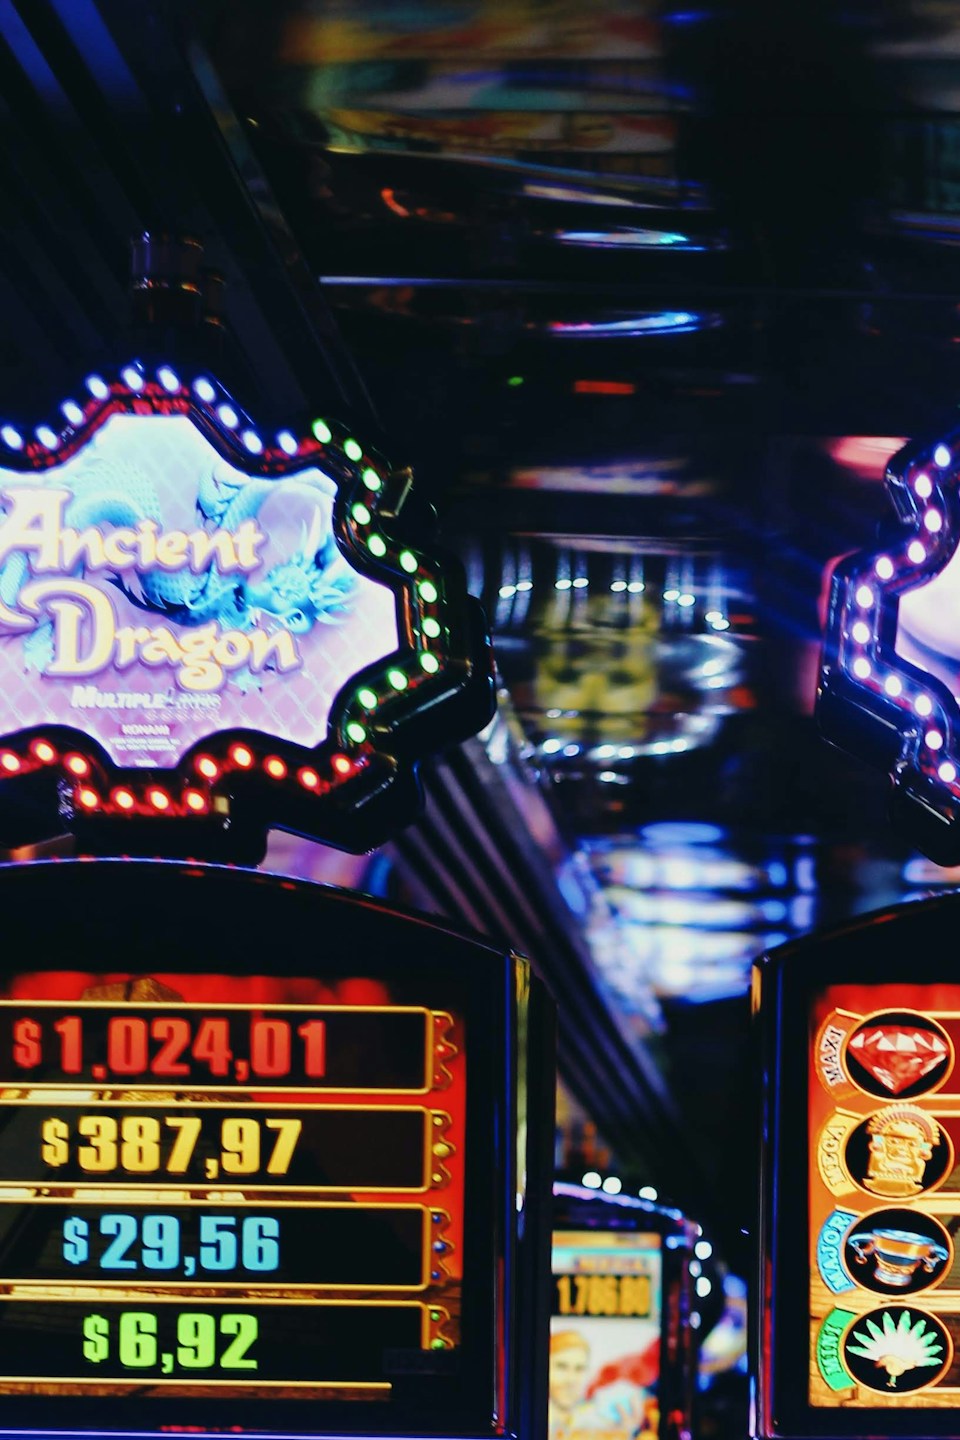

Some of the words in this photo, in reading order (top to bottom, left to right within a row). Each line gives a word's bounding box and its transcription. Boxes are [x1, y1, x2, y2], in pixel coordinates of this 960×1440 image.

[0, 487, 266, 571] Ancient
[20, 579, 302, 691] Dragon
[820, 1026, 847, 1087] MAXI
[41, 1115, 303, 1179] $387,97
[821, 1122, 848, 1188] MEGA
[62, 1213, 281, 1277] $29,56
[822, 1214, 852, 1293] MAJOR
[82, 1311, 259, 1375] $6,92
[822, 1322, 845, 1378] MINI
